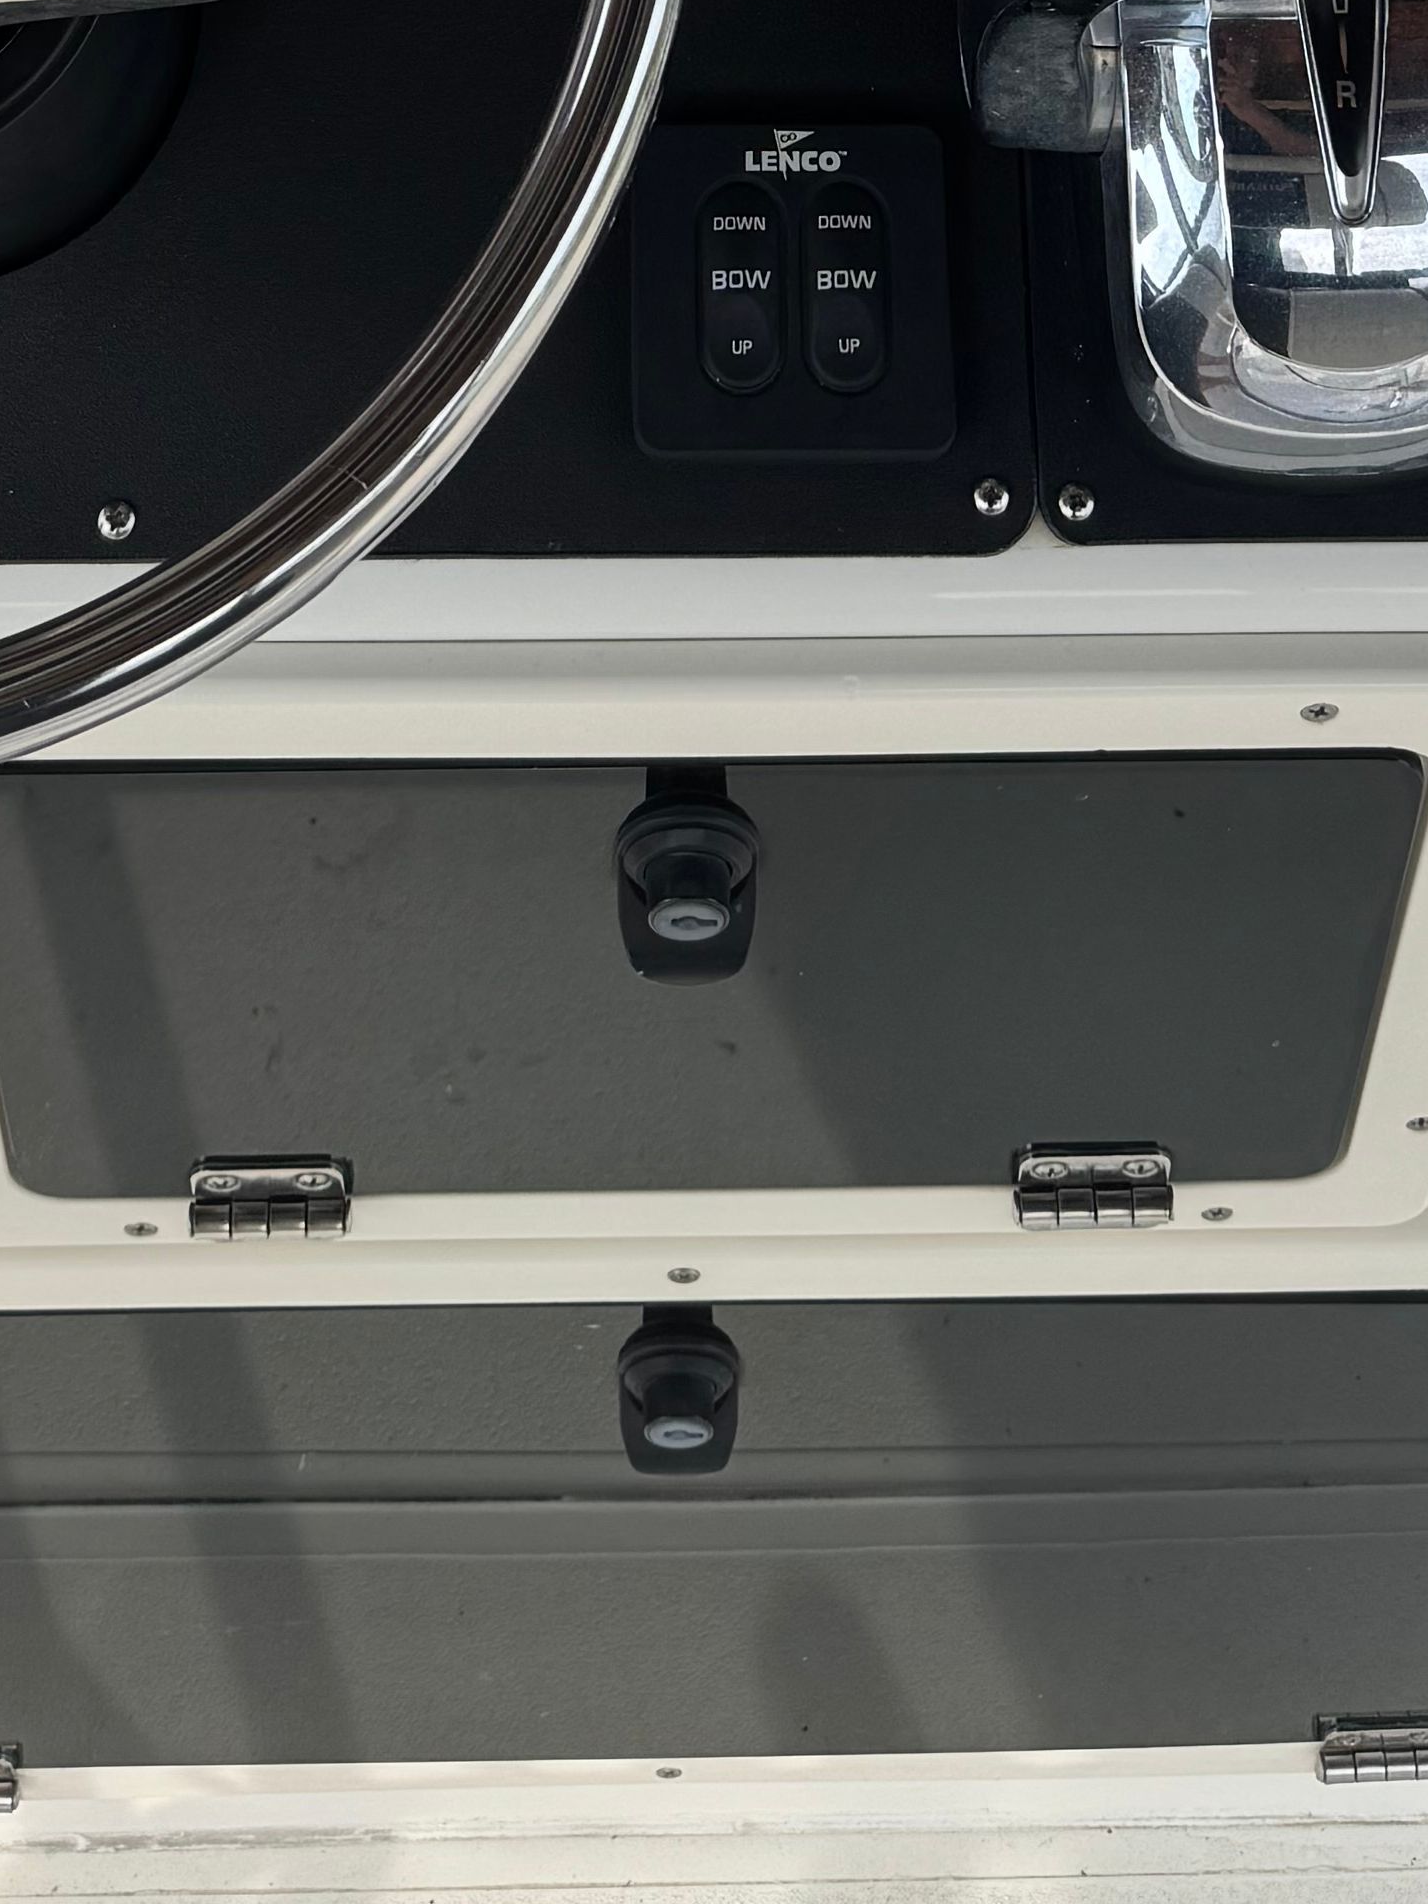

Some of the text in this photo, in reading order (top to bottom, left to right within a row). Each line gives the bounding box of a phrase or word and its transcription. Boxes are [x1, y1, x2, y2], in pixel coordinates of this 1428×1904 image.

[1335, 79, 1358, 109] R
[744, 149, 842, 173] LENCO
[713, 216, 767, 232] DOWN
[817, 214, 872, 230] DOWN
[711, 269, 772, 291] BOW
[816, 269, 877, 291] BOW
[731, 340, 754, 356] UP
[838, 338, 861, 354] UP
